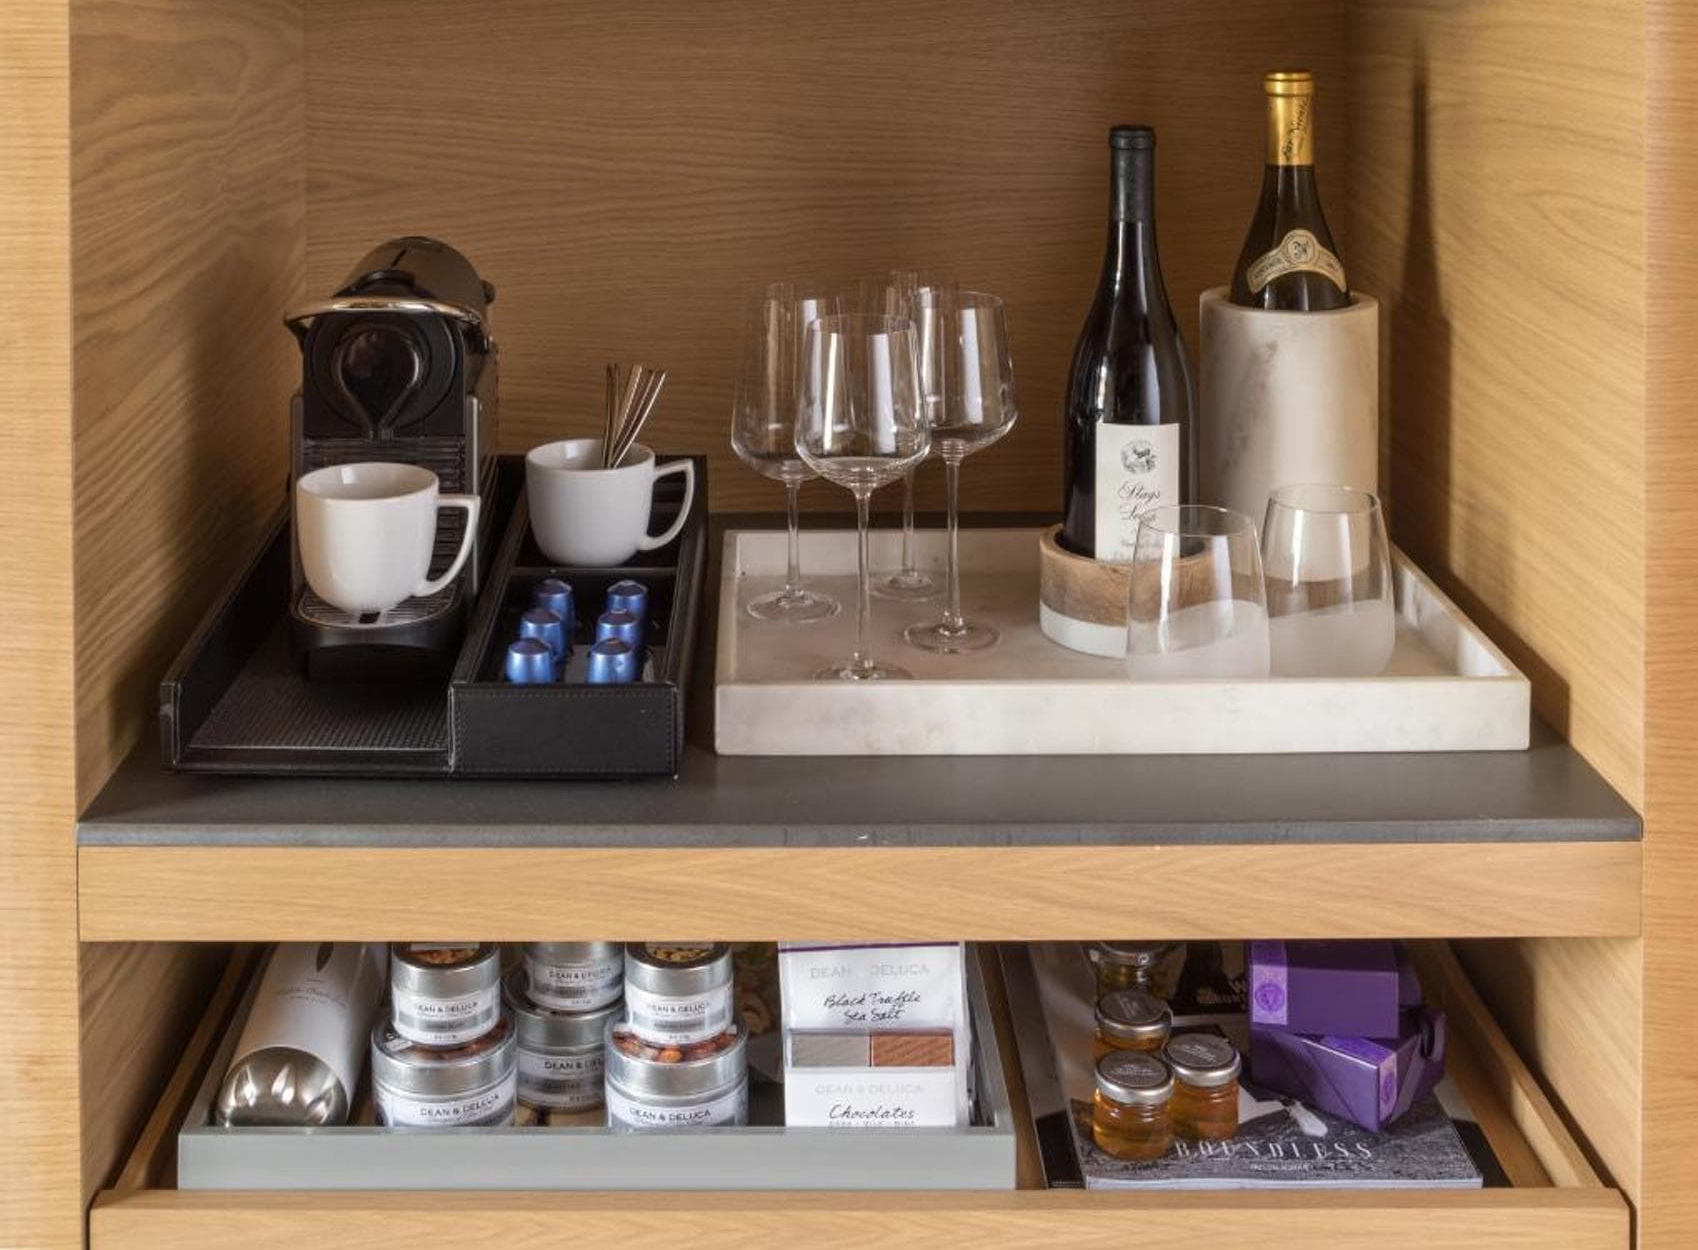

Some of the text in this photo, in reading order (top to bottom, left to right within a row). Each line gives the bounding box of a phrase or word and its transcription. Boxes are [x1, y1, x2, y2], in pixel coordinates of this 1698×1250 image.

[810, 966, 853, 979] DEAN
[824, 990, 921, 1009] Black Truffle
[843, 1008, 905, 1025] Sea Salt
[545, 1060, 573, 1069] DEAN
[420, 1108, 450, 1117] DEAN
[630, 1107, 656, 1120] DEAN
[668, 1109, 711, 1121] DELUCA
[829, 1103, 916, 1120] Chocolates
